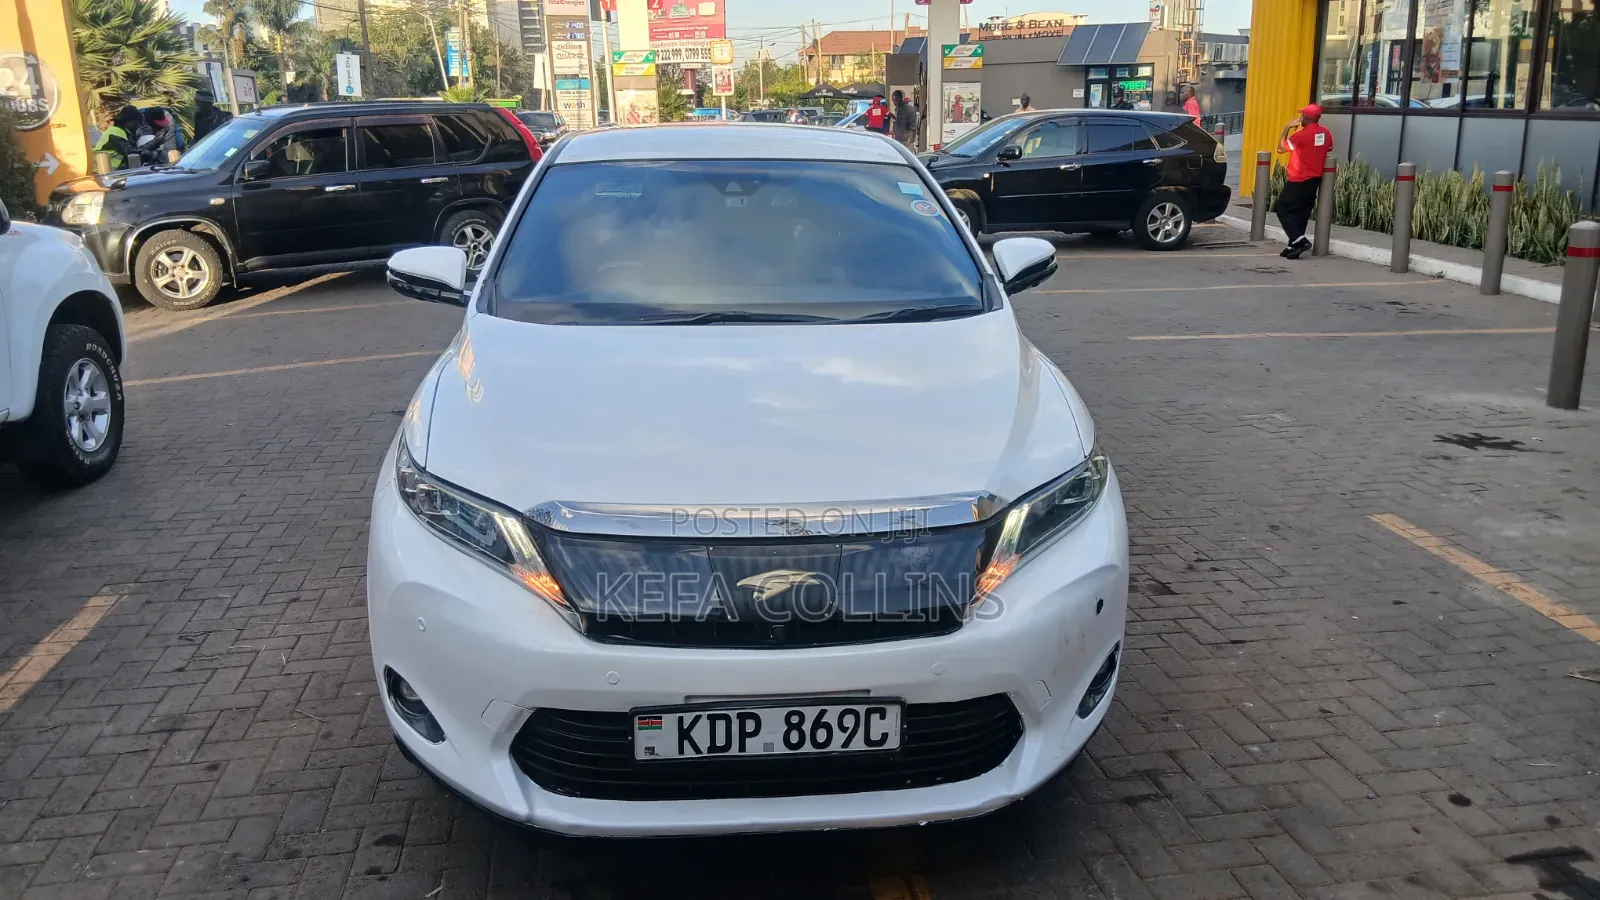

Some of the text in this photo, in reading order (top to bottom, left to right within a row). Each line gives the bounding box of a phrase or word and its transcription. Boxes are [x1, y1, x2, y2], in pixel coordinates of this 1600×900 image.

[979, 19, 1063, 32] MUGG & BEAN
[1033, 30, 1063, 38] MOVE
[1119, 81, 1146, 90] CYBER
[3, 97, 49, 113] OURS
[563, 101, 585, 109] wash
[677, 711, 762, 756] KDP
[782, 706, 889, 751] 869C
